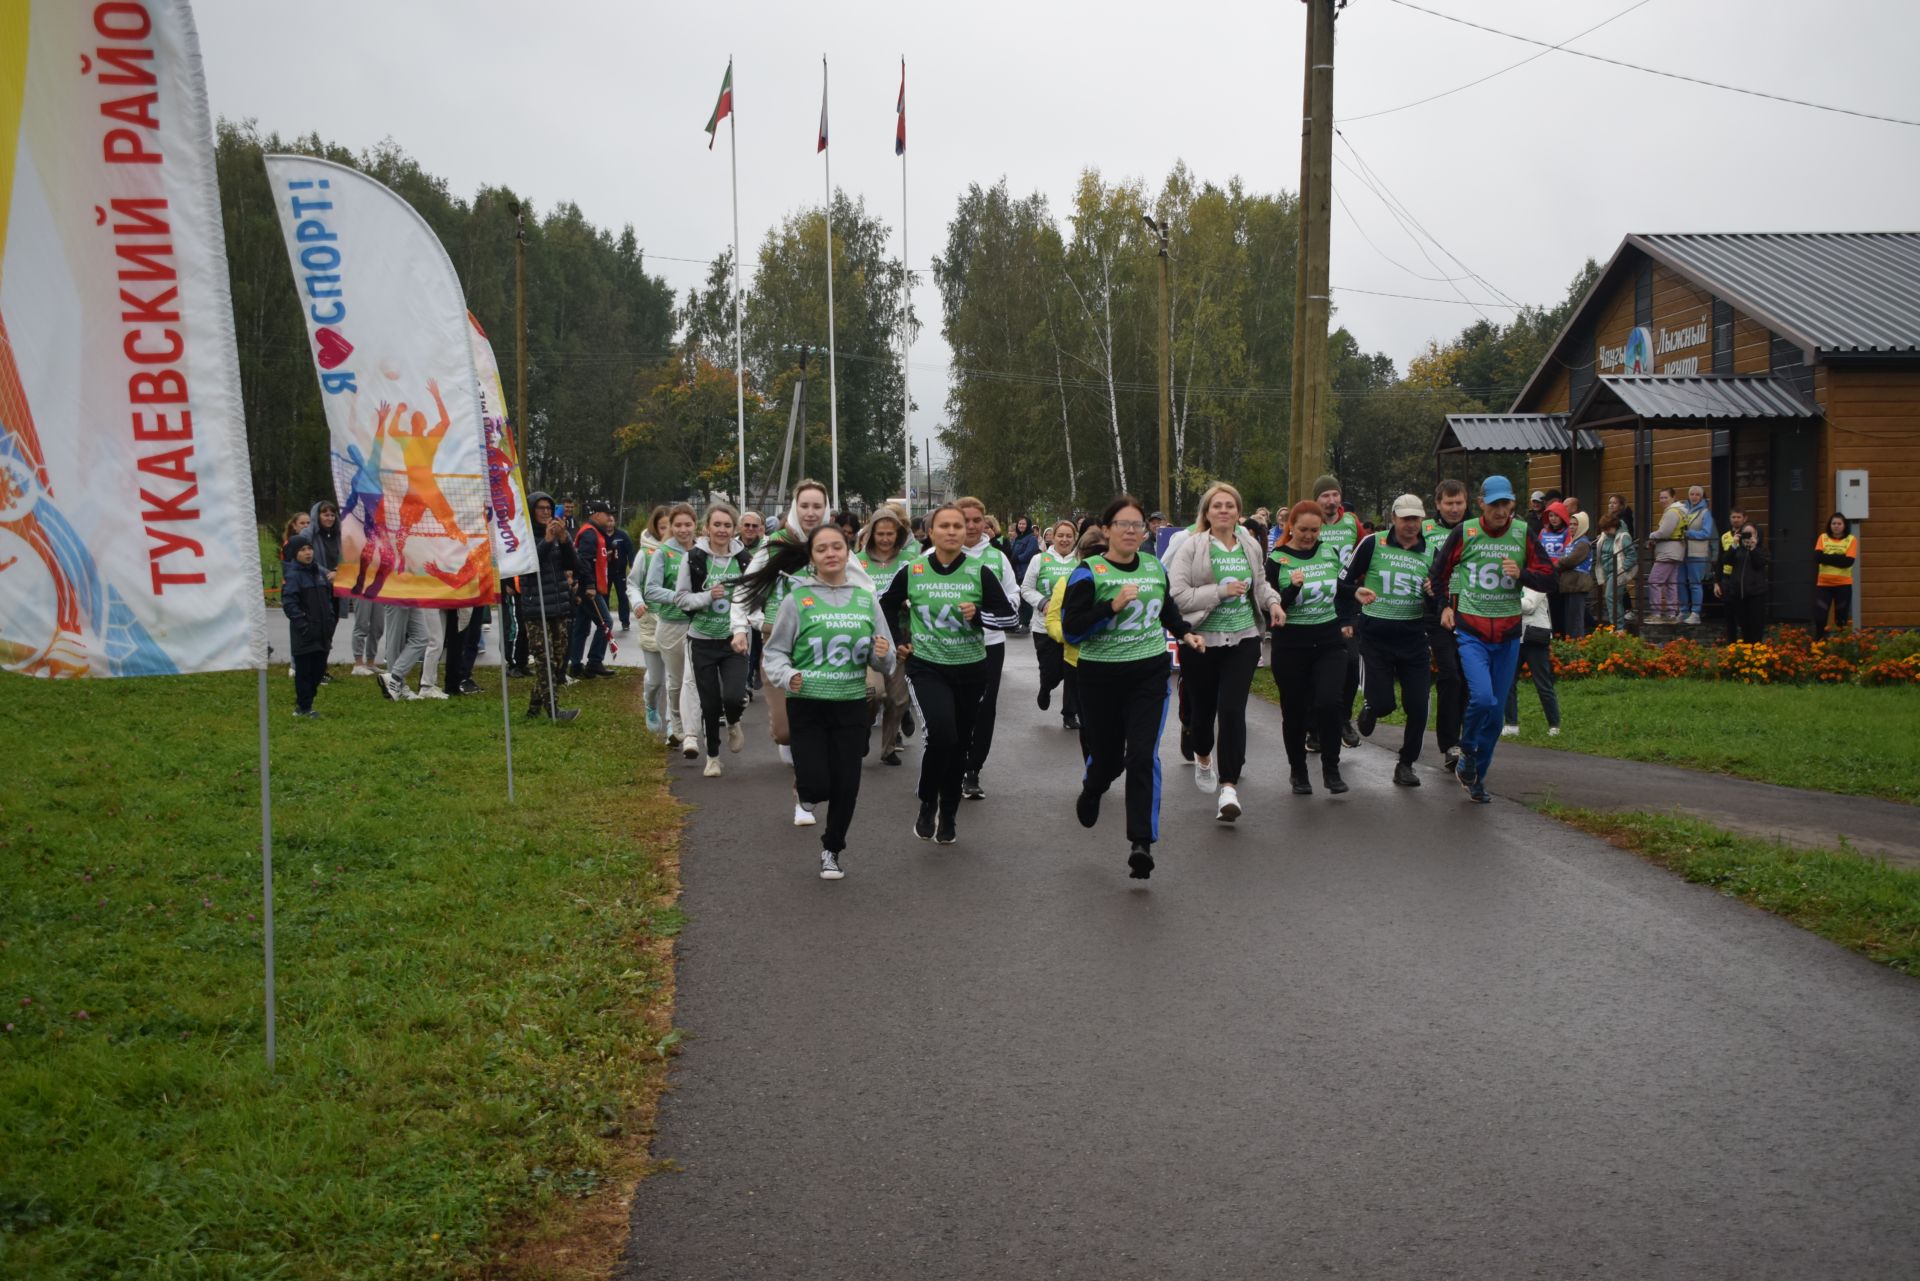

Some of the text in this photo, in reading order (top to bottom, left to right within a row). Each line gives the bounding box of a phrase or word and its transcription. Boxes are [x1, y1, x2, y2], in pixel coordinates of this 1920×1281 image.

[288, 179, 358, 395] Я СПОРТ!
[80, 1, 208, 596] ТУКАЕВСКИЙ РАЙО
[1656, 314, 1708, 355] Лыжный
[1380, 552, 1426, 567] ТУКАЕВСКИЙ
[1390, 560, 1417, 570] РАЙОН
[916, 582, 975, 591] ТУКАЕВСКИЙ
[928, 590, 961, 599] РАЙОН
[809, 613, 871, 623] ТУКАЕВСКИЙ
[826, 619, 862, 629] РАЙОН
[917, 604, 972, 632] 14
